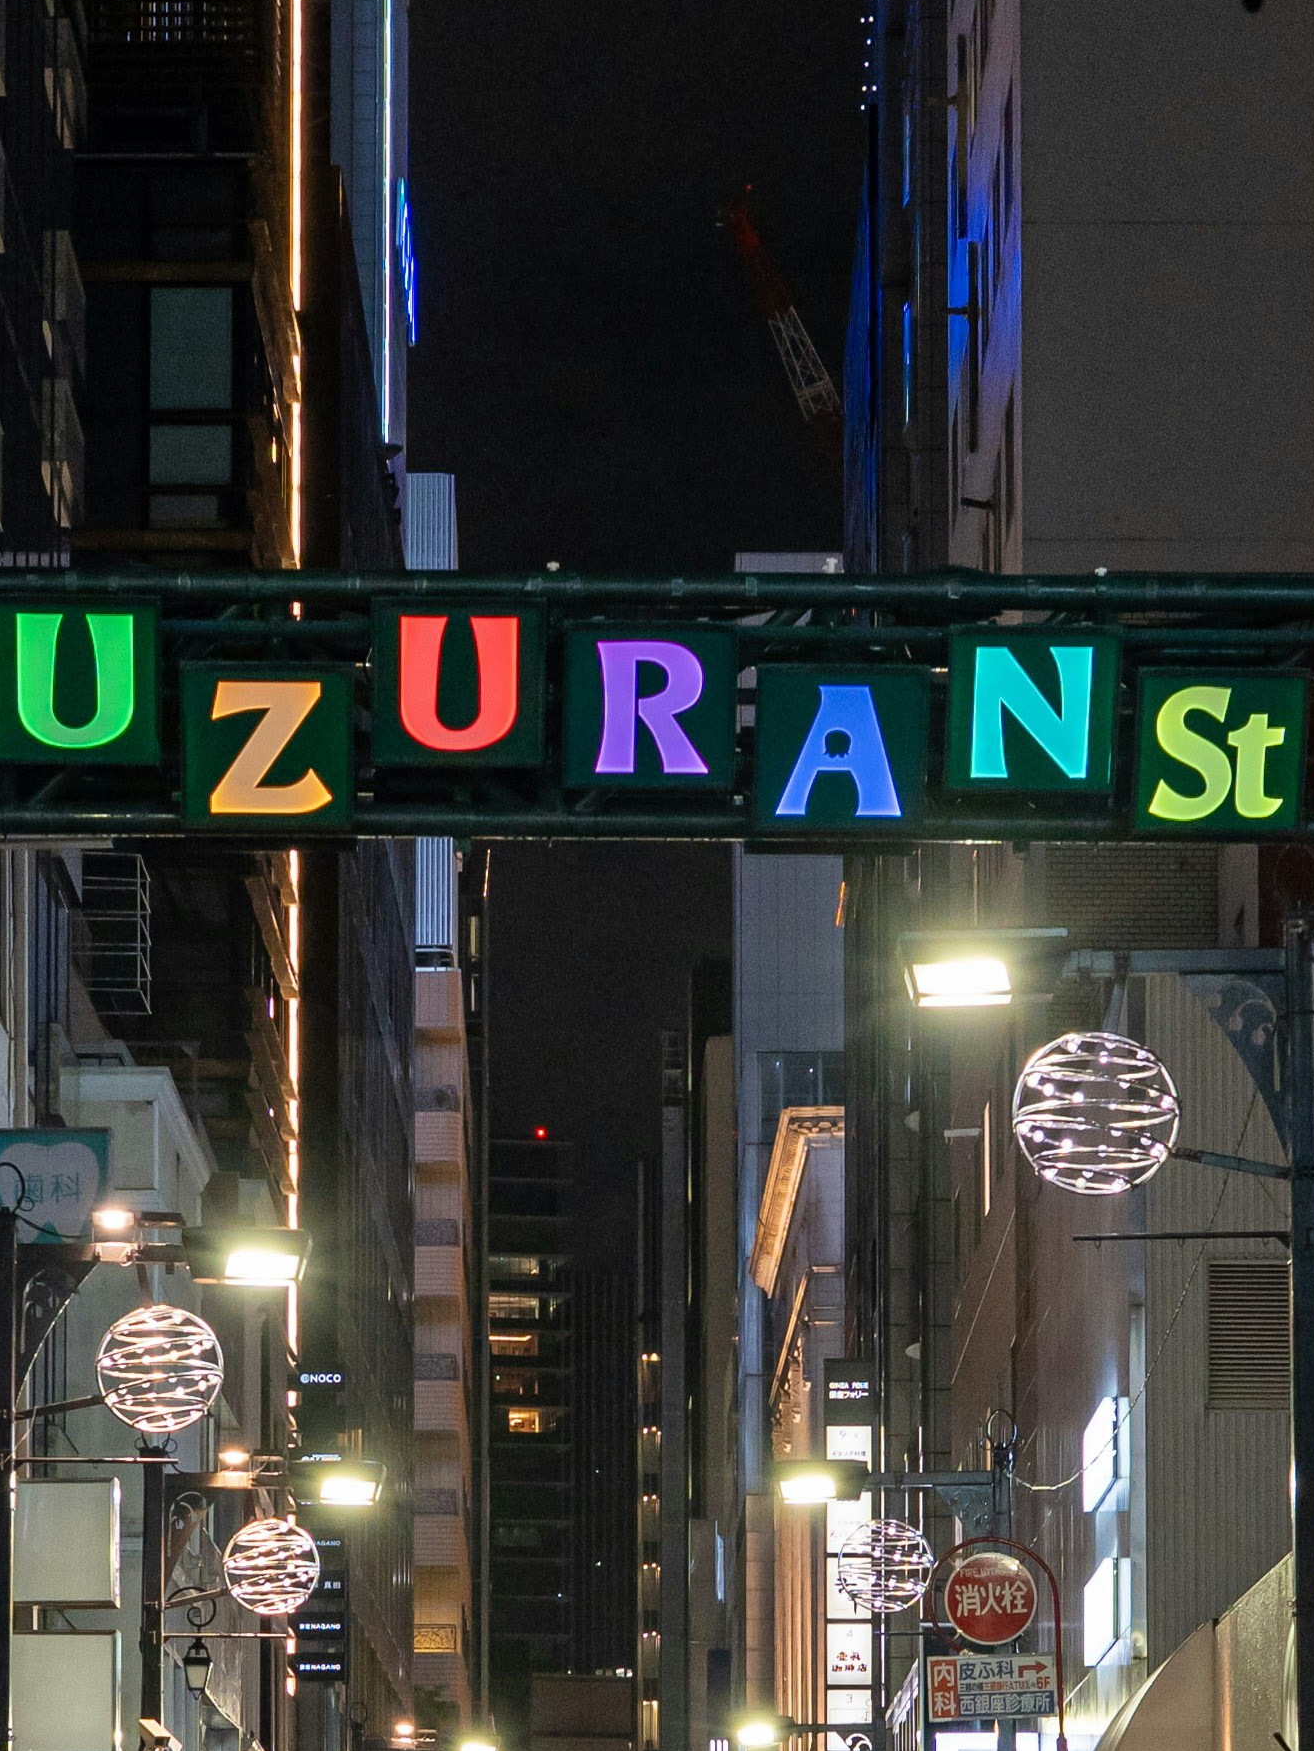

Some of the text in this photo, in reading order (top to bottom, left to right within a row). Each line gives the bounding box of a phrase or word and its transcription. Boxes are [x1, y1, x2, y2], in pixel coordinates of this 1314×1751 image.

[1148, 685, 1286, 822] St
[954, 1580, 1028, 1618] 消火栓
[932, 1662, 957, 1716] 内科
[958, 1660, 1015, 1681] 皮ふ科
[960, 1692, 1051, 1715] 西銀座診療所
